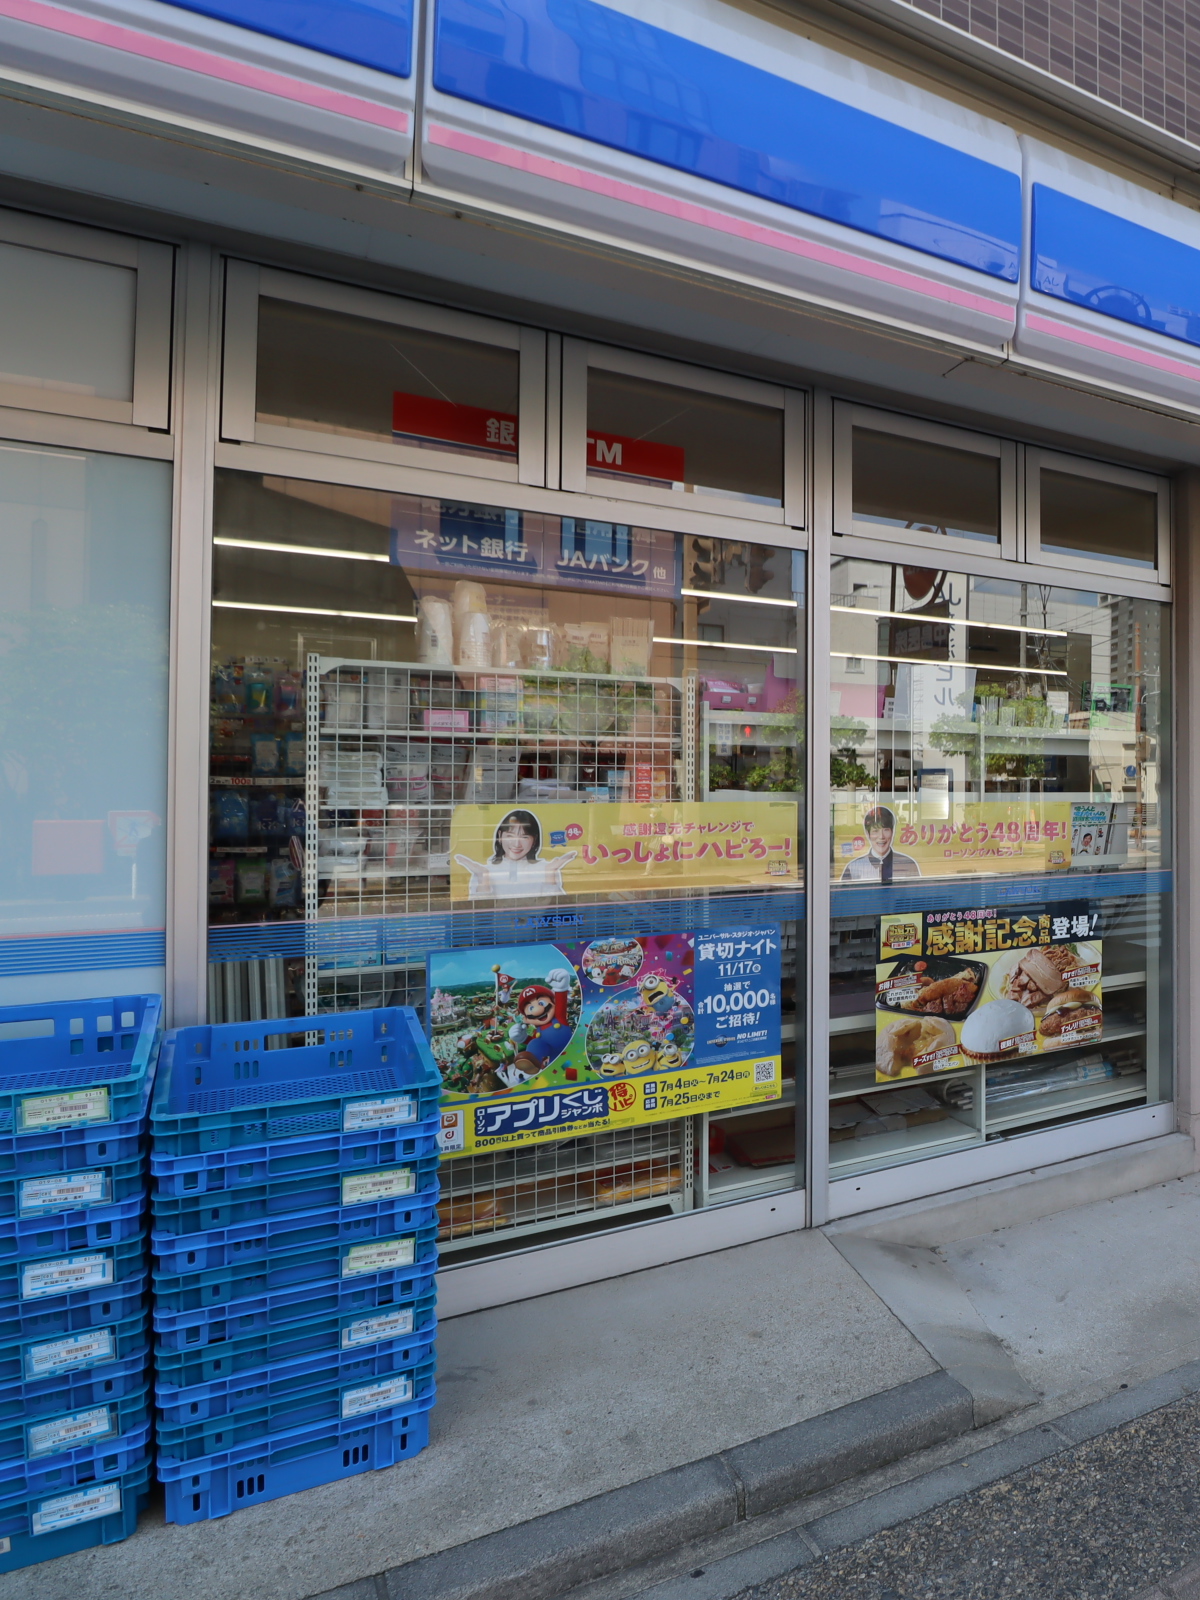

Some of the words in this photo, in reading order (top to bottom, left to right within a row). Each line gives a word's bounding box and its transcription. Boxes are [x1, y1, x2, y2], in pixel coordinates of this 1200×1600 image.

[414, 529, 529, 562] ネット銀行
[557, 549, 649, 577] JAバンク
[623, 821, 755, 836] 感謝還元チャレンジで
[900, 821, 1067, 845] ありがとう48周年!
[582, 837, 791, 864] いっしょにハピろー!
[514, 915, 584, 929] LAWSON
[927, 909, 997, 923] ありがとう48周年!
[698, 939, 777, 961] 貸切ナイト
[724, 981, 750, 991] 抽選で
[716, 1012, 760, 1028] ご招待!
[477, 1109, 485, 1134] ローソン
[486, 1089, 603, 1132] アプリくじ
[561, 1103, 603, 1119] ジャンボ
